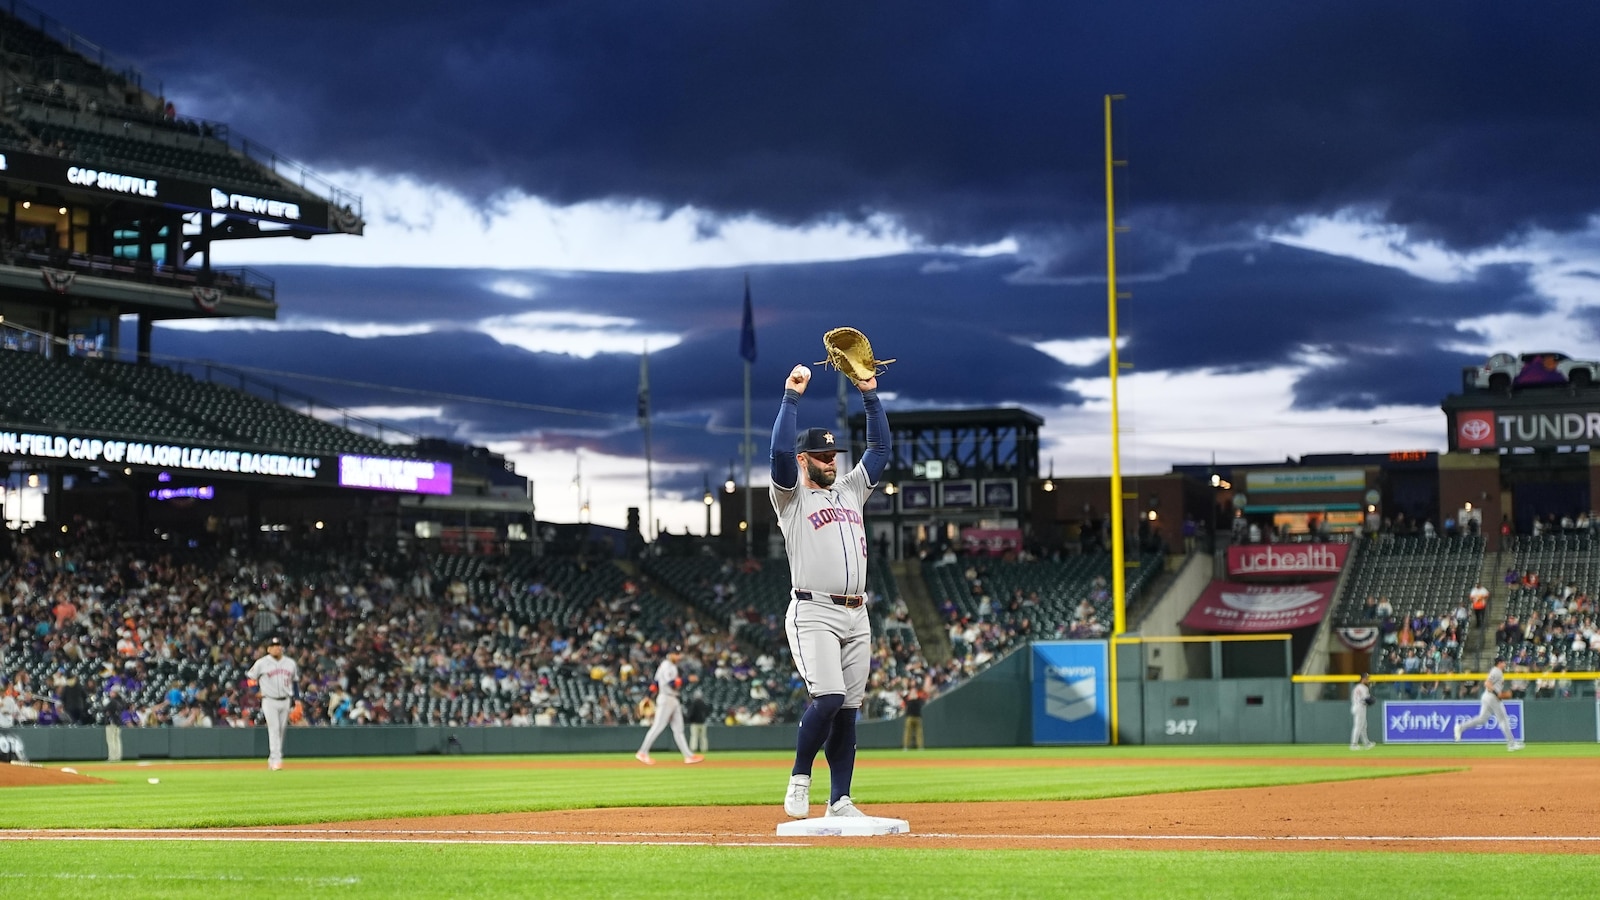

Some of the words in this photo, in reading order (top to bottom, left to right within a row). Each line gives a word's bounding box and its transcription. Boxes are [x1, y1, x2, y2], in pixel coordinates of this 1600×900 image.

[67, 166, 97, 186] CAP
[97, 172, 158, 197] SHUFFLE
[0, 431, 69, 458] N-FIELD
[68, 438, 103, 460] CAP
[103, 440, 127, 463] OF
[126, 442, 182, 467] MAJOR
[181, 447, 240, 472] LEAGUE
[1240, 544, 1337, 571] uchealth
[1165, 720, 1197, 735] 347
[1390, 710, 1451, 733] xfinity
[1455, 713, 1518, 730] mbe
